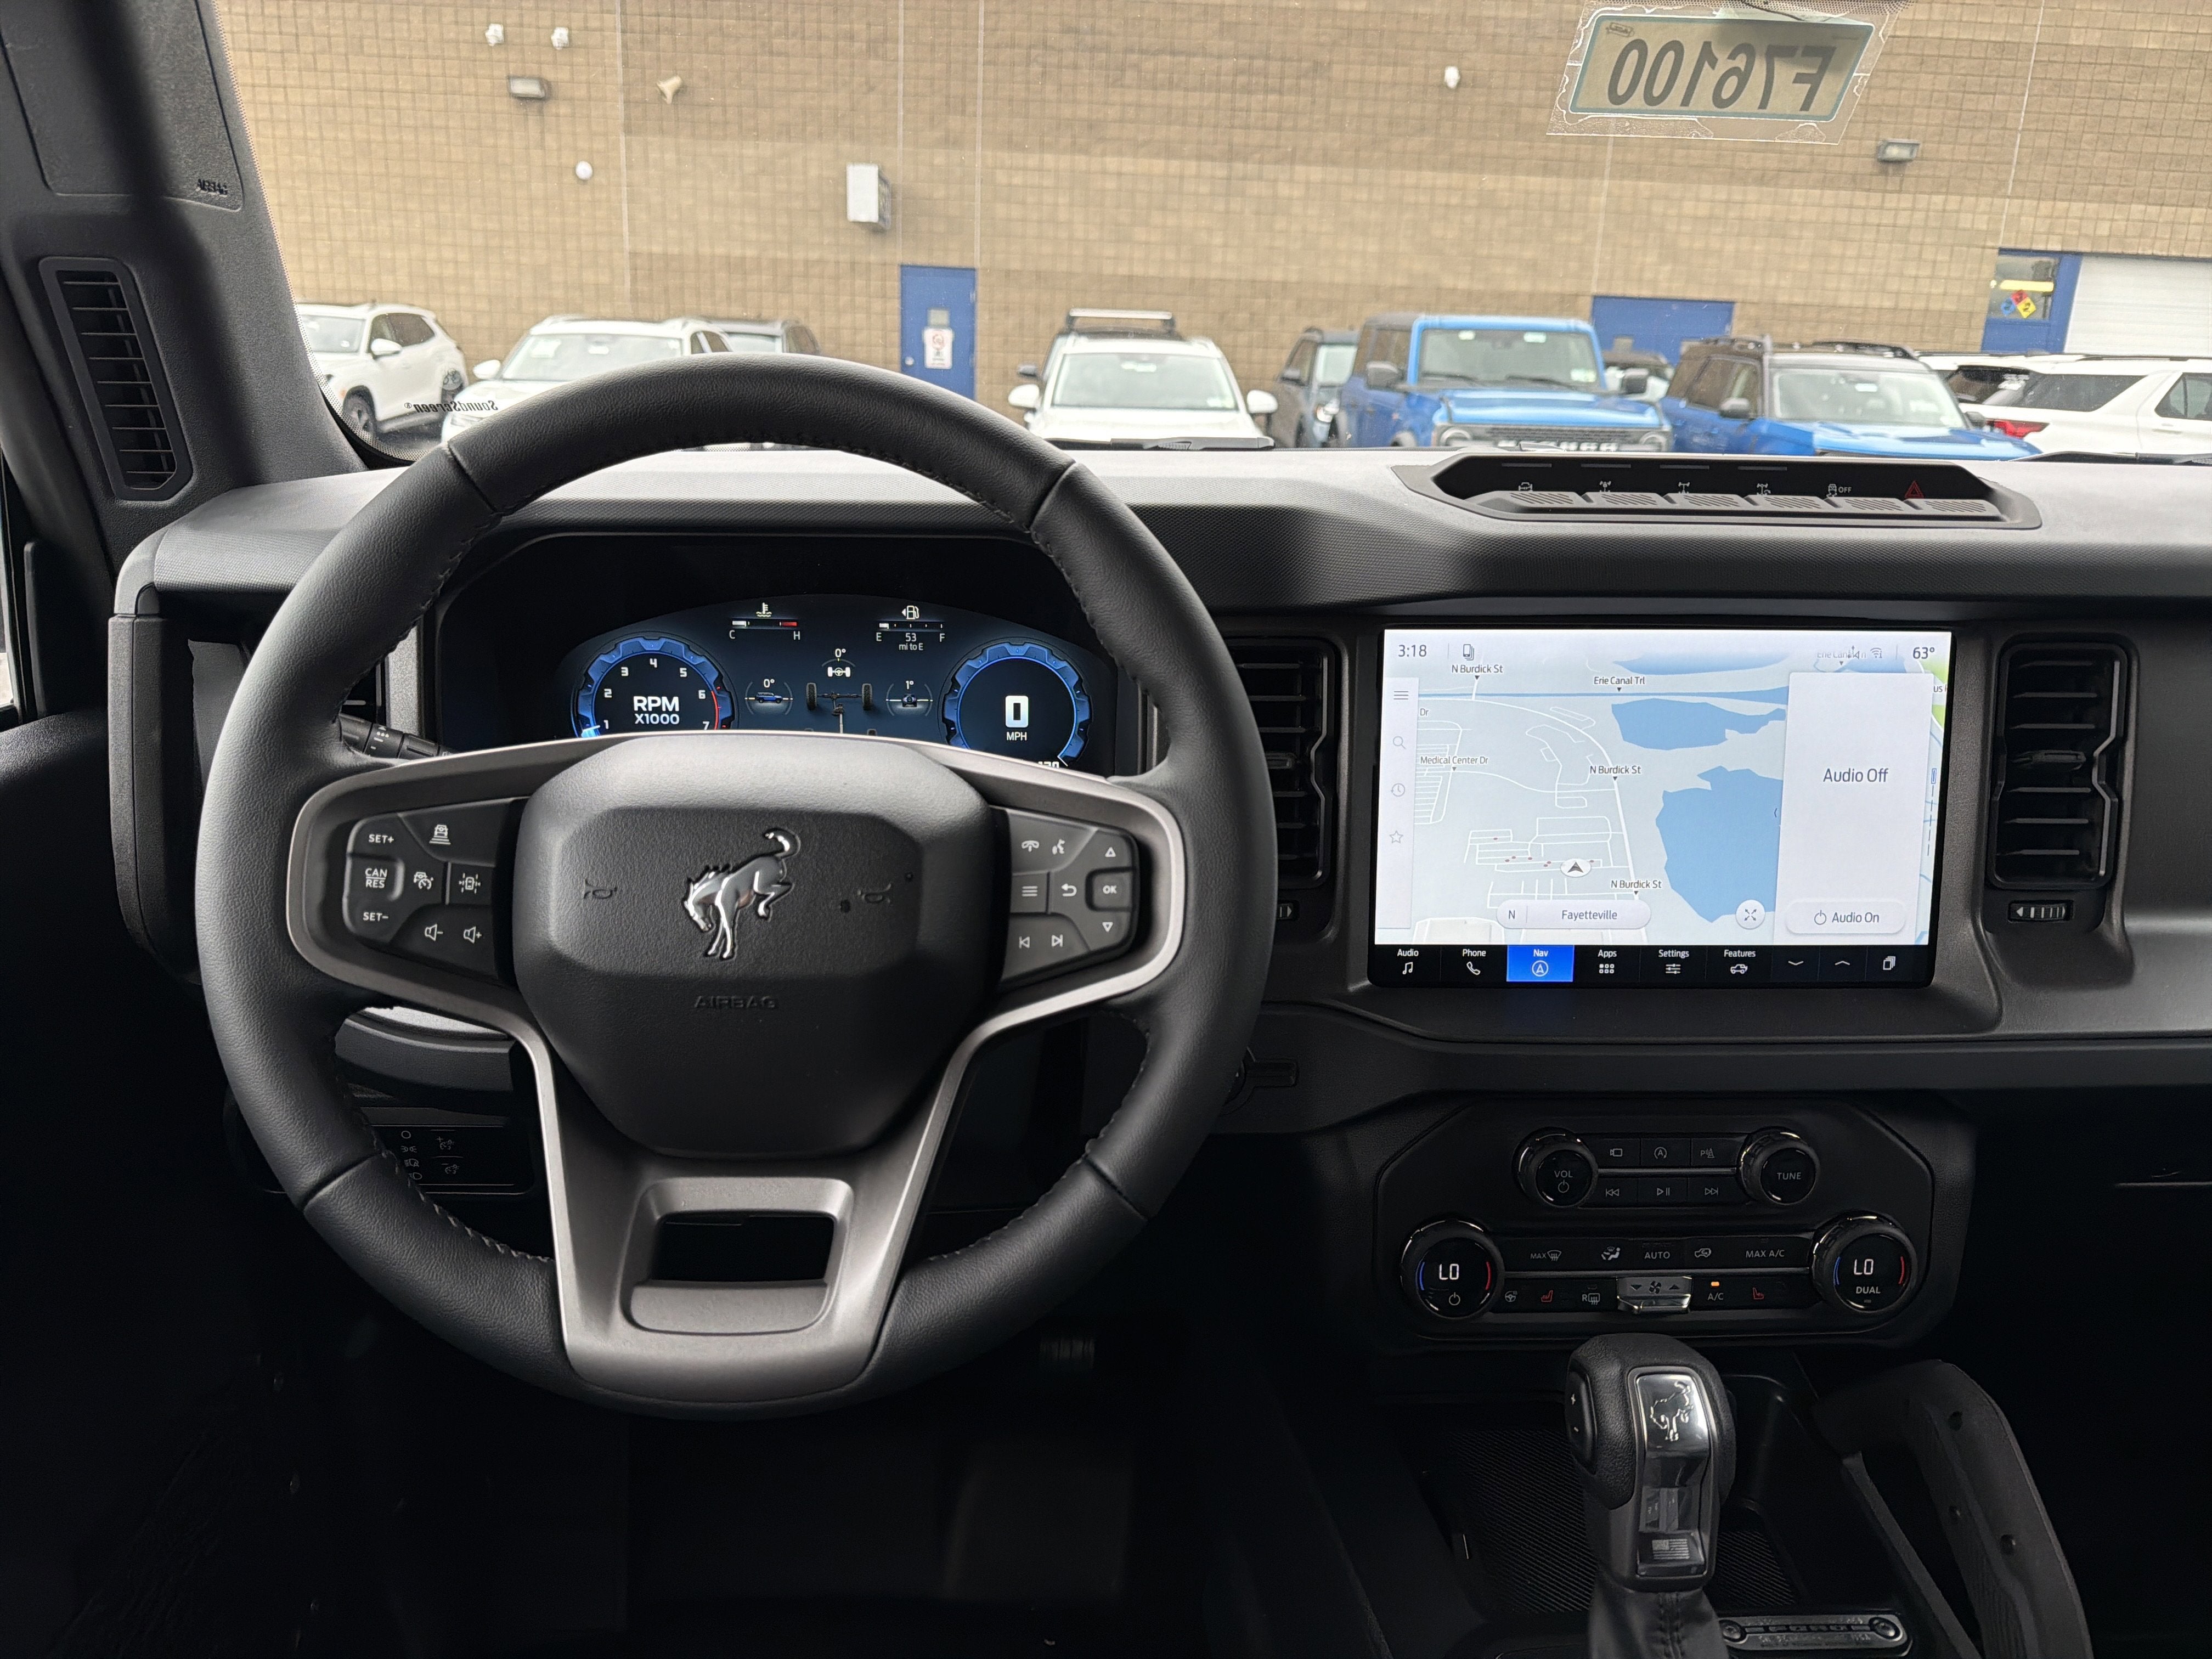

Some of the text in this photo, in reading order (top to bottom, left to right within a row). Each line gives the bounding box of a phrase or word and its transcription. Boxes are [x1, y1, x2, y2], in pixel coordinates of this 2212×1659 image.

[729, 630, 736, 640] C
[793, 631, 800, 640] H
[876, 632, 882, 641] E
[905, 633, 917, 642] 53
[939, 633, 945, 642] F
[834, 648, 846, 657] 0°
[1398, 644, 1427, 657] 3:18
[1912, 646, 1935, 659] 63°
[650, 658, 657, 668] 4
[621, 667, 629, 676] 3
[680, 668, 687, 677] 5
[1452, 664, 1503, 673] N Burdick St
[763, 679, 775, 688] 0°
[1594, 676, 1645, 685] Erie Canal Trl
[906, 681, 914, 690] 1°
[604, 689, 612, 698] 2
[698, 690, 706, 699] 6
[633, 696, 680, 712] RPM
[1005, 695, 1029, 728] 0
[1420, 708, 1429, 716] Dr
[635, 713, 680, 725] X1000
[603, 720, 610, 730] 1
[702, 721, 710, 730] 7
[1006, 731, 1028, 741] MPH
[1420, 756, 1488, 764] Medical Center Dr
[1590, 765, 1641, 774] N Burdick St
[1823, 768, 1889, 783] Audio Off
[368, 834, 394, 844] SET+
[365, 868, 388, 877] CAN
[365, 879, 385, 888] RES
[1611, 879, 1662, 889] N Burdick St
[1102, 885, 1117, 894] OK
[1508, 910, 1516, 919] N
[1561, 909, 1618, 923] Fayetteville
[1832, 911, 1880, 923] Audio On
[1397, 949, 1419, 957] Audio
[1462, 949, 1486, 957] Phone
[1533, 949, 1549, 957] Nav
[1598, 949, 1617, 960] Apps
[1658, 949, 1689, 960] Settings
[1724, 949, 1756, 958] Features
[693, 995, 775, 1009] AIRBAG
[1554, 1170, 1573, 1178] VOL
[1777, 1172, 1802, 1181] TUNE
[1644, 1251, 1671, 1260] AUTO
[1746, 1250, 1785, 1258] MAX A/C
[1855, 1286, 1881, 1295] DUAL
[1707, 1293, 1724, 1301] A/C
